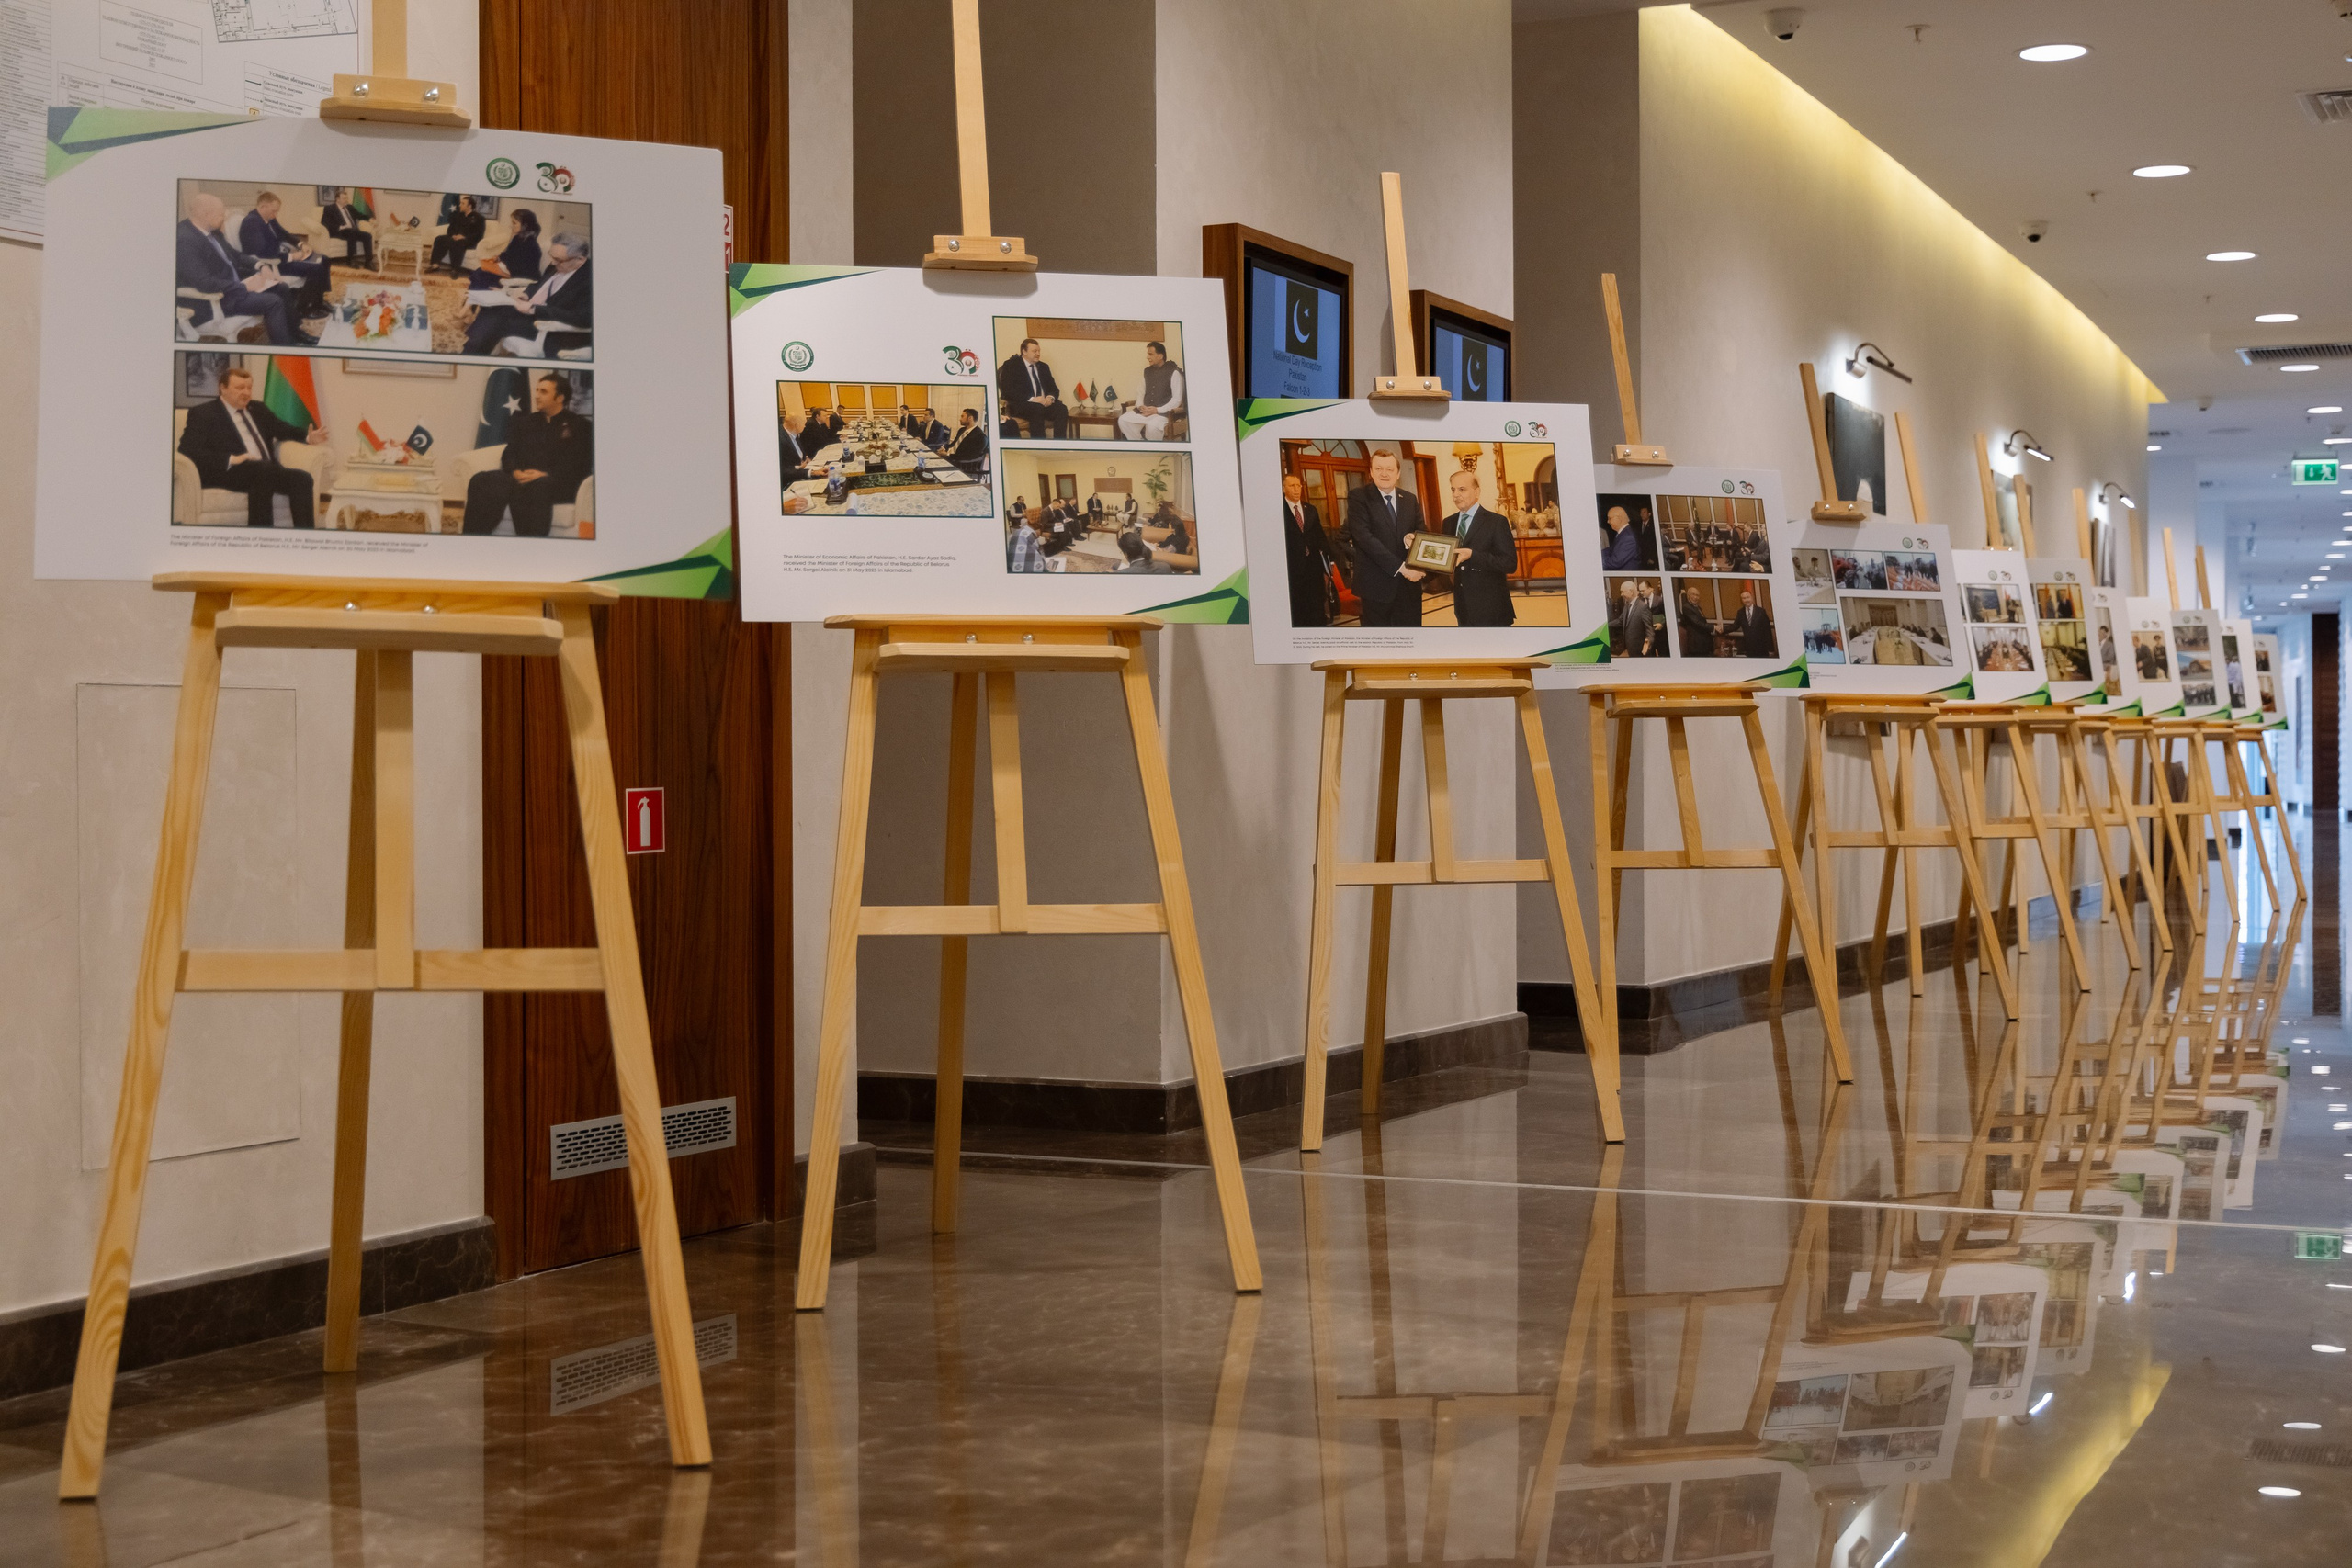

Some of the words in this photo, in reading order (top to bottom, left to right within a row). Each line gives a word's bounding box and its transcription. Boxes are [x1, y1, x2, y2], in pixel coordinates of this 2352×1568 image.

[1273, 350, 1291, 364] National
[1292, 355, 1300, 368] Day
[1301, 357, 1322, 372] Reception
[1288, 368, 1306, 382] Pakistan
[1284, 381, 1298, 393] Falcon
